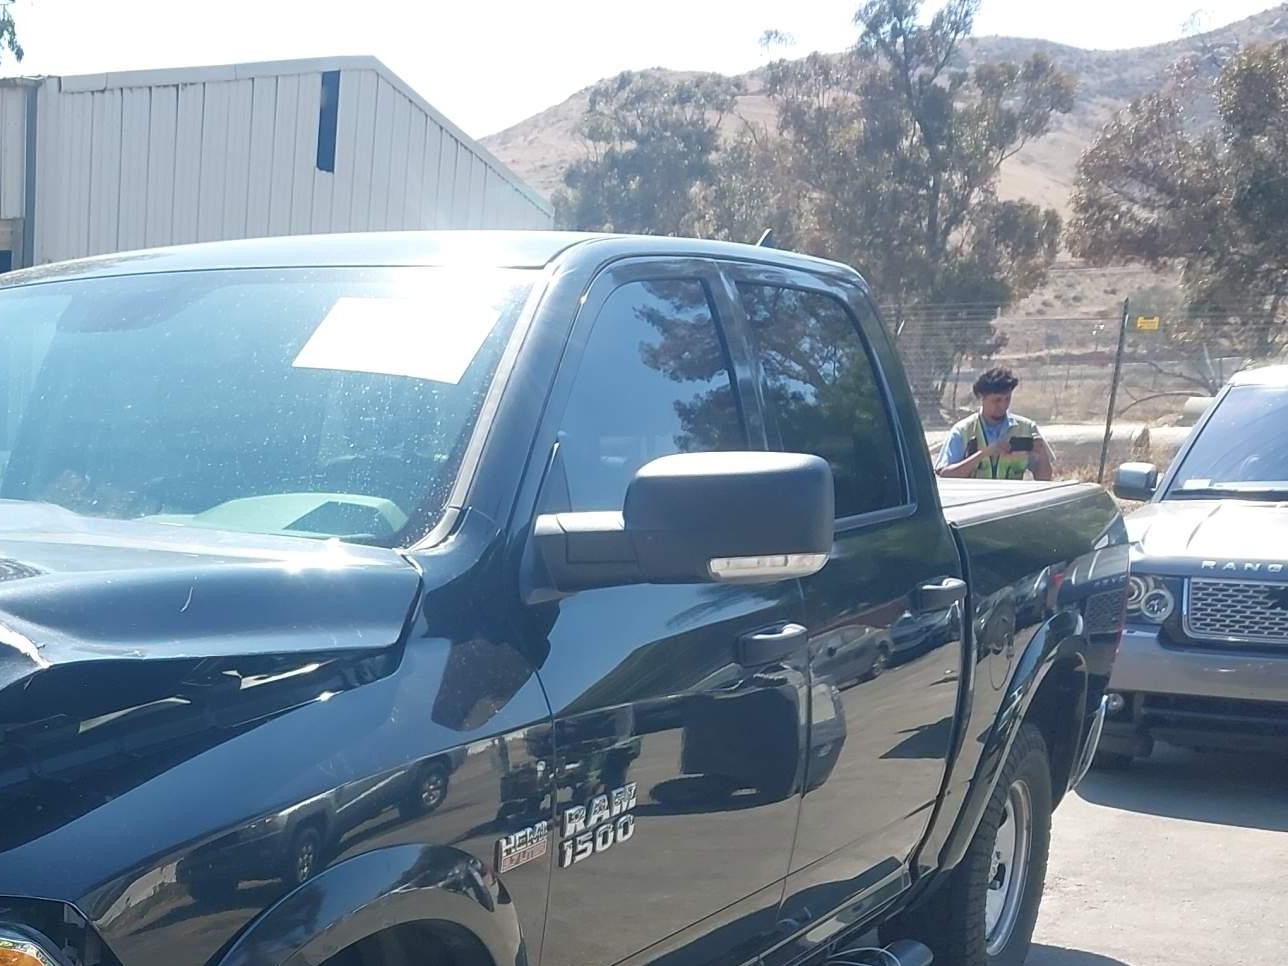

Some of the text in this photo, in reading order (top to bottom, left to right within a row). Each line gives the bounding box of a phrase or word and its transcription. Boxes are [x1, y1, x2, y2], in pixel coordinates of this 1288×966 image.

[562, 782, 637, 838] RAM
[500, 819, 548, 857] HEMI
[562, 813, 635, 868] 1500
